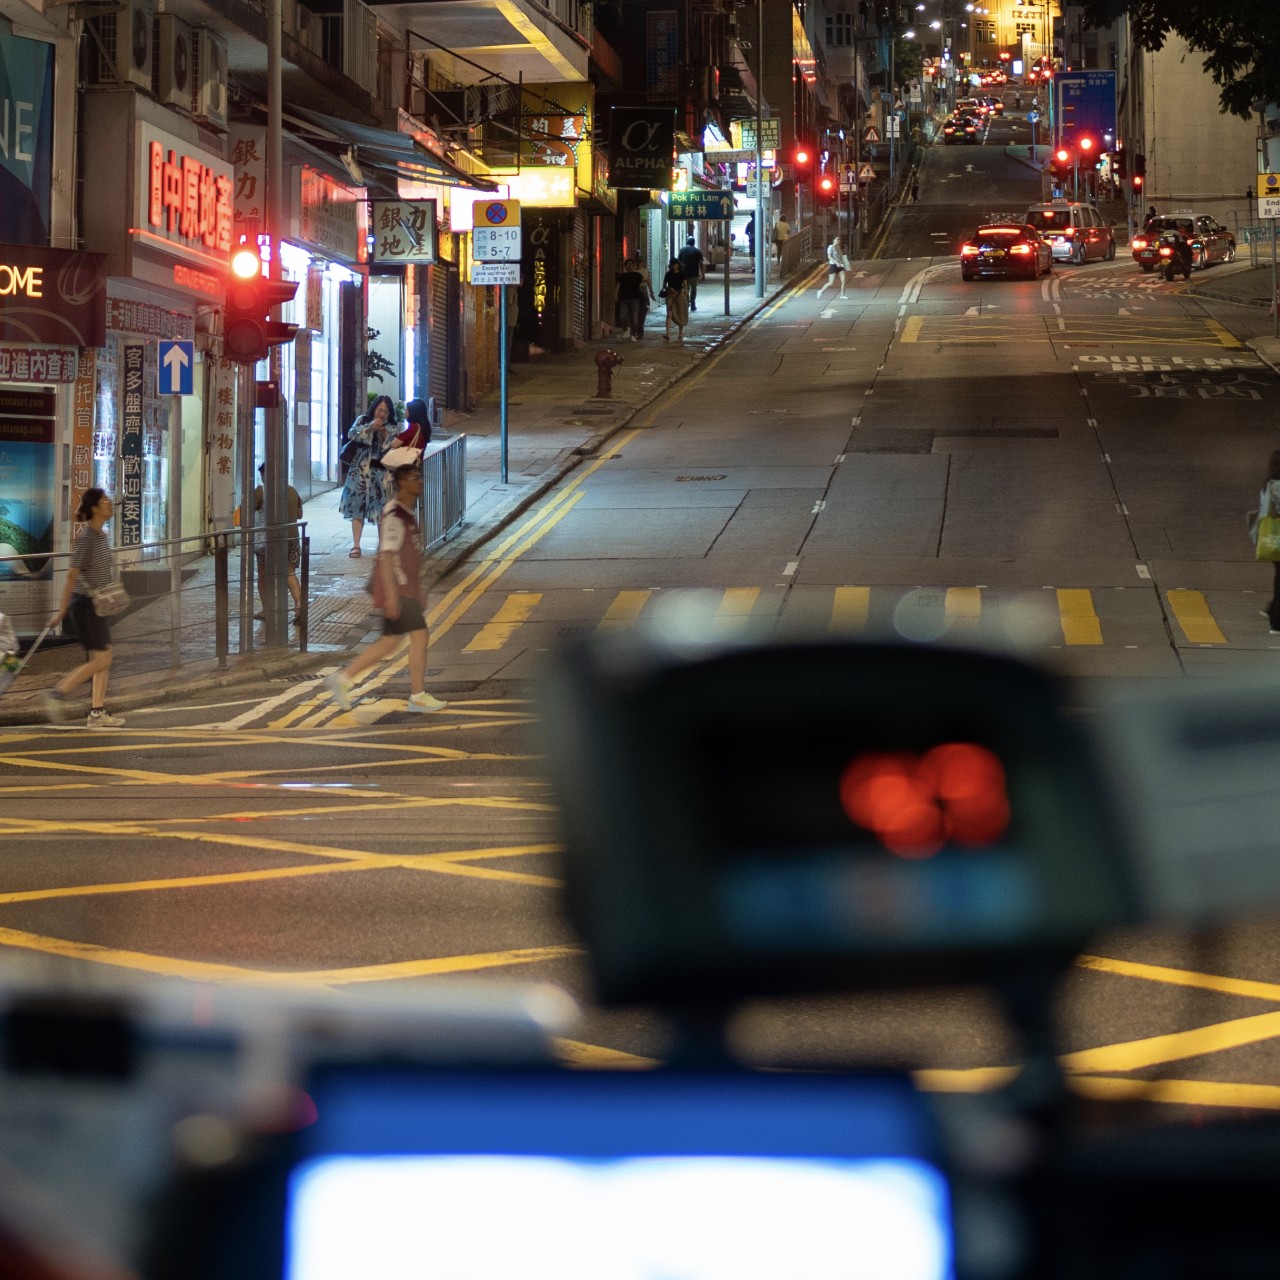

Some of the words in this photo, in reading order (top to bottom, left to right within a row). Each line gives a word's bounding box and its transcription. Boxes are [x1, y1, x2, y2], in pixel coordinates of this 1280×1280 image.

[232, 138, 261, 200] 銀力
[164, 150, 232, 252] 中原地產
[672, 193, 687, 202] Pok
[690, 193, 700, 202] Fu
[703, 193, 719, 202] Lam
[490, 231, 518, 241] 8-10
[491, 247, 511, 257] 5-7
